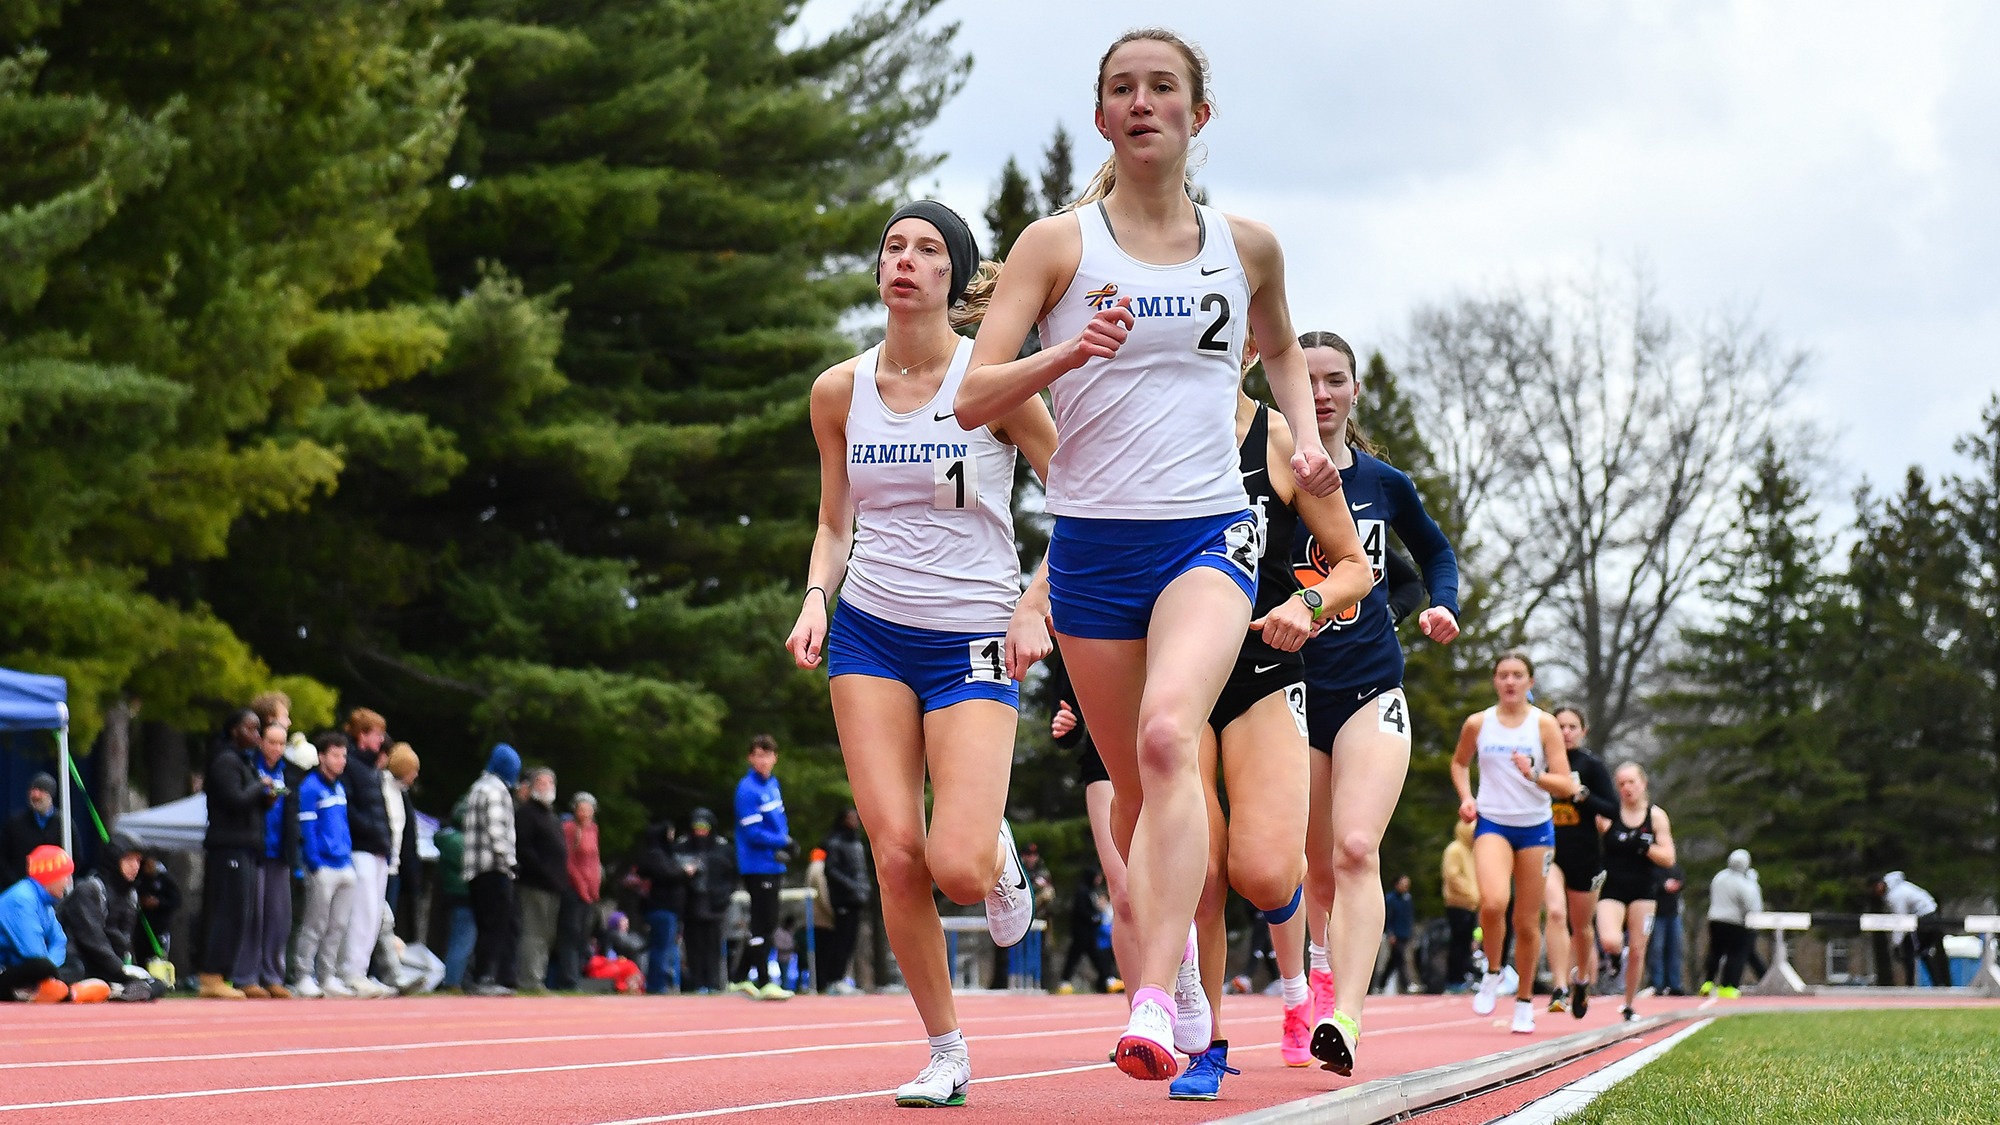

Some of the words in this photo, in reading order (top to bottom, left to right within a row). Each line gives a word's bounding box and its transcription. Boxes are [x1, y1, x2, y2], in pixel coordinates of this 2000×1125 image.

[1197, 292, 1231, 352] 2
[851, 443, 968, 464] HAMILTON
[945, 460, 965, 509] 1
[1363, 523, 1383, 565] 4
[980, 640, 1003, 681] 1
[1383, 697, 1405, 734] 4
